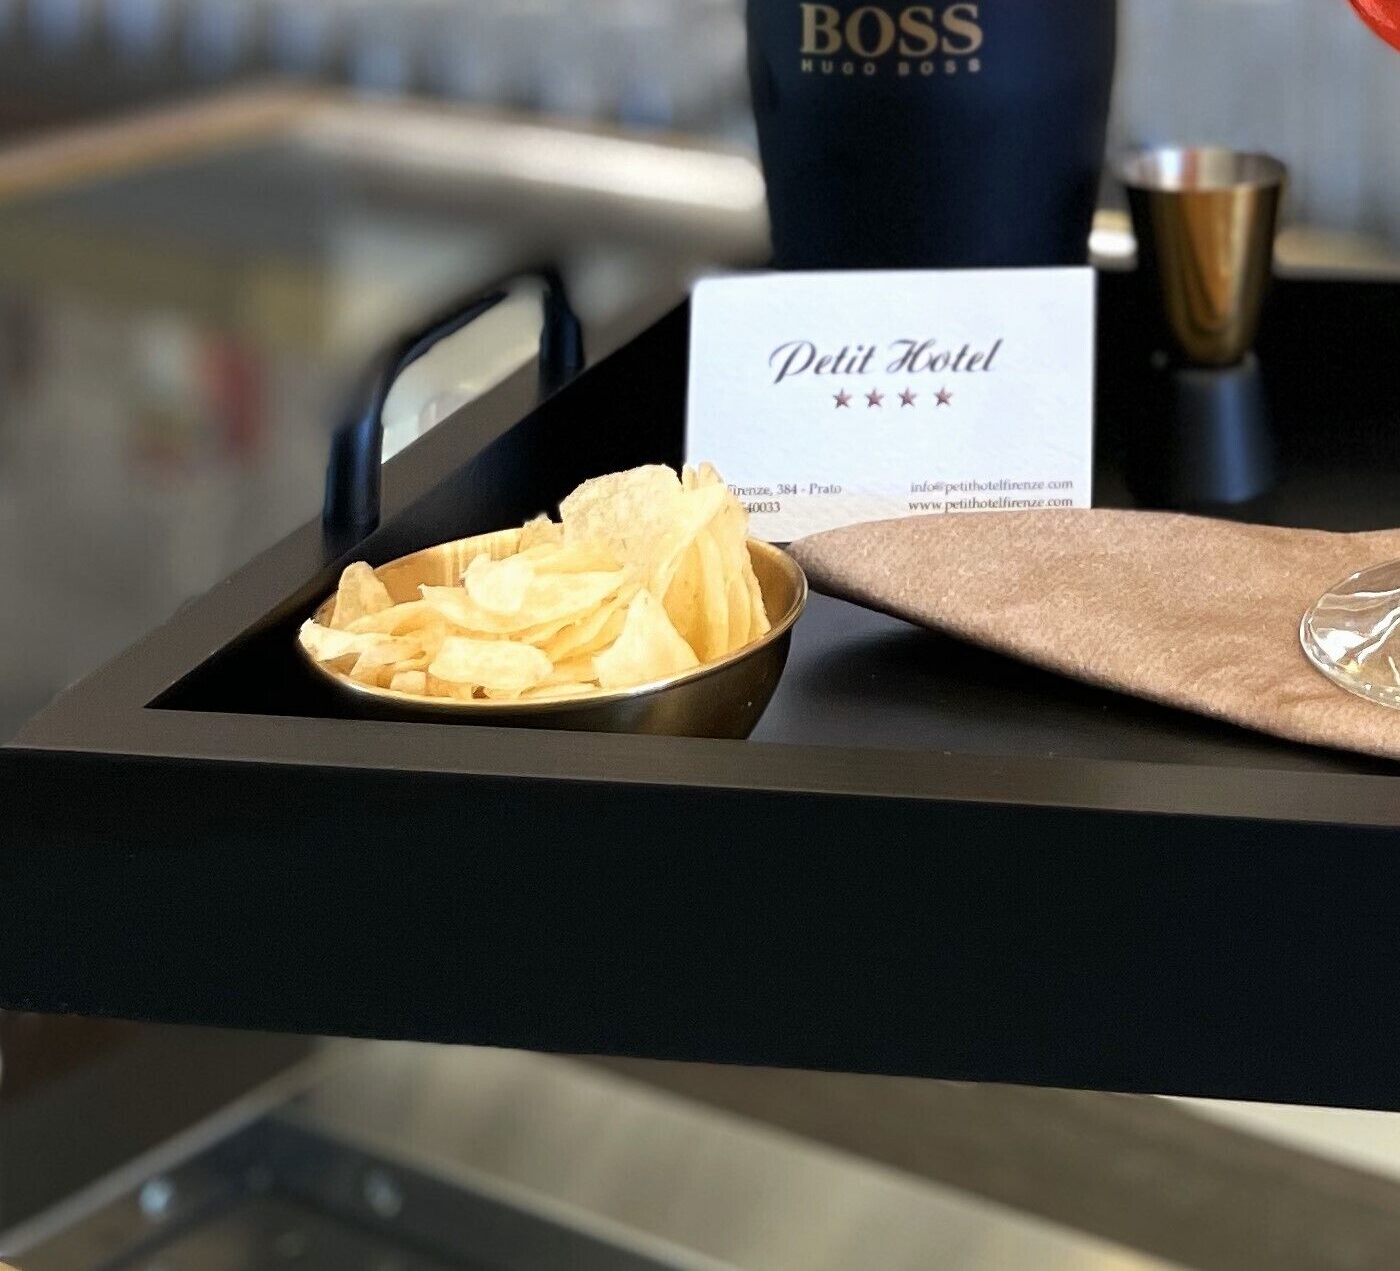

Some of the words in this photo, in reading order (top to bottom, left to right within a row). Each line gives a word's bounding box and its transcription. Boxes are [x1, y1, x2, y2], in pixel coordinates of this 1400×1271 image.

[800, 3, 983, 58] BOSS
[801, 58, 876, 76] HUGO
[898, 57, 981, 76] BOSS
[768, 340, 876, 385] Petit
[886, 338, 1004, 374] Hotel
[776, 483, 798, 495] 384
[809, 483, 843, 495] Prato
[910, 478, 1074, 496] info@petithotelfirenze.com
